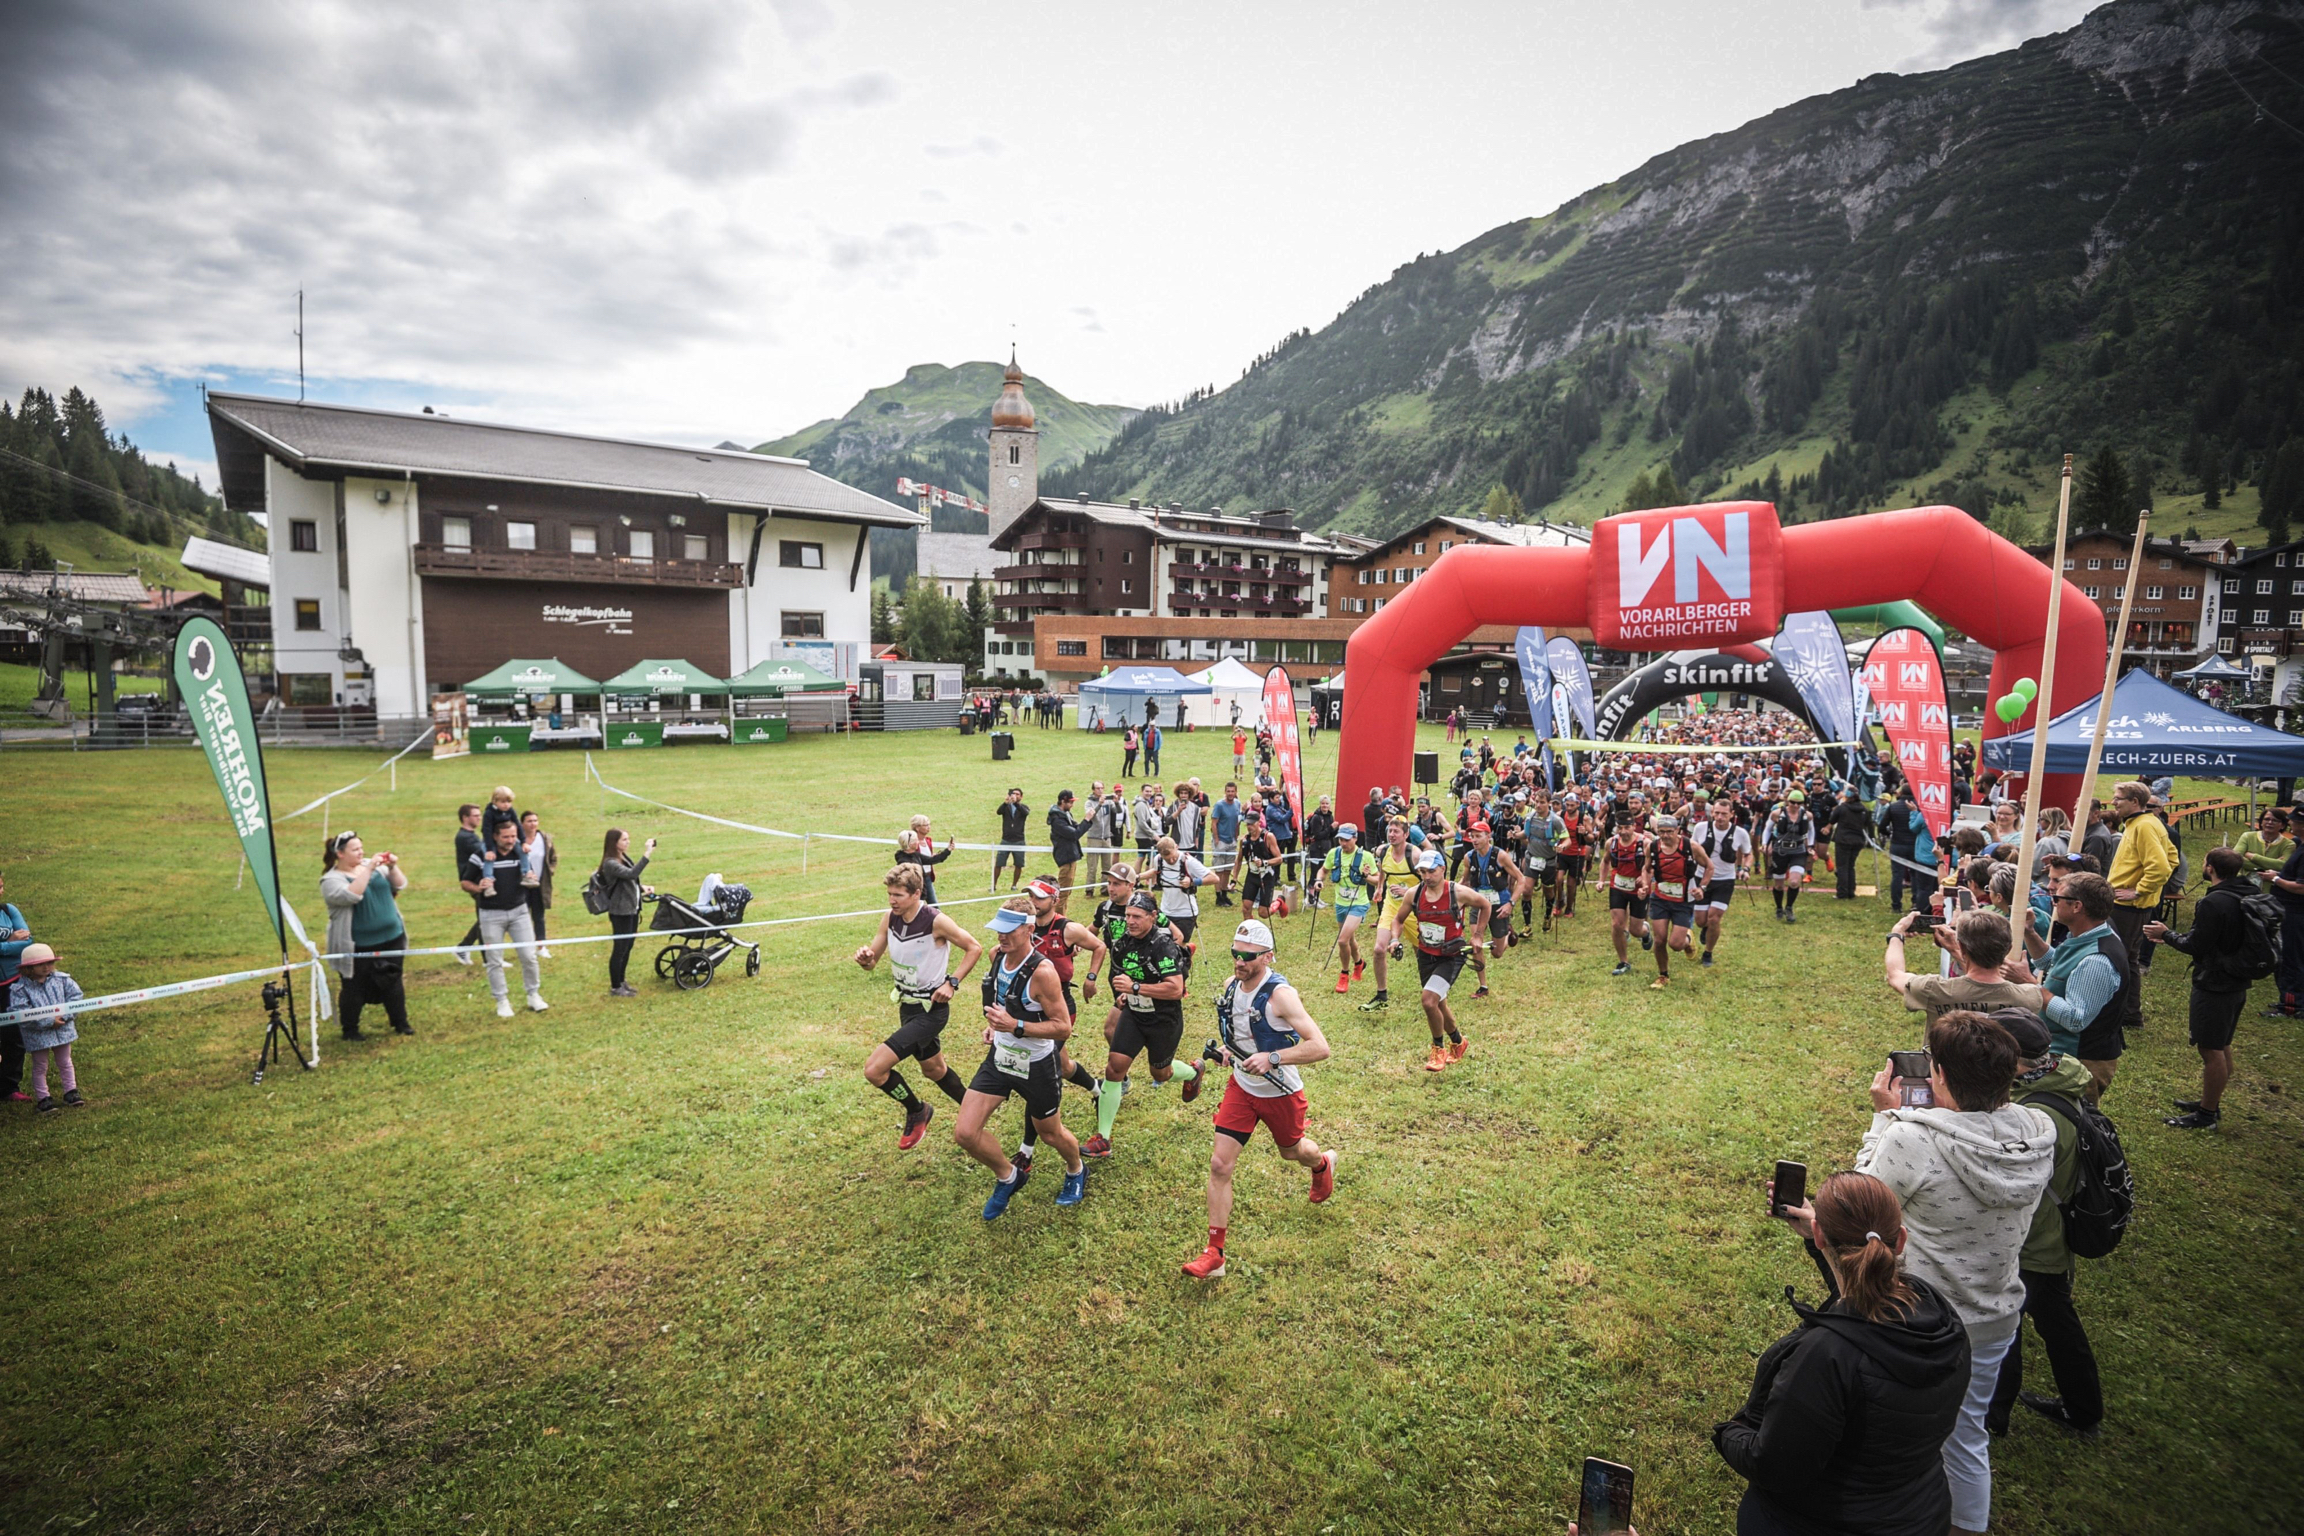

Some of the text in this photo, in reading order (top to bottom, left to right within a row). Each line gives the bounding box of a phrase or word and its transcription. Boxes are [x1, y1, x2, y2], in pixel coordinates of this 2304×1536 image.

[1618, 511, 1751, 608] VN
[542, 605, 633, 619] Schlegelkopfbahn
[1619, 601, 1752, 625] VORARLBERGER
[1620, 618, 1738, 640] NACHRICHTEN
[1664, 662, 1770, 684] skinfit
[2079, 715, 2139, 728] Lch
[2166, 725, 2252, 733] ARLBERG
[24, 1009, 54, 1018] SPARKASSE
